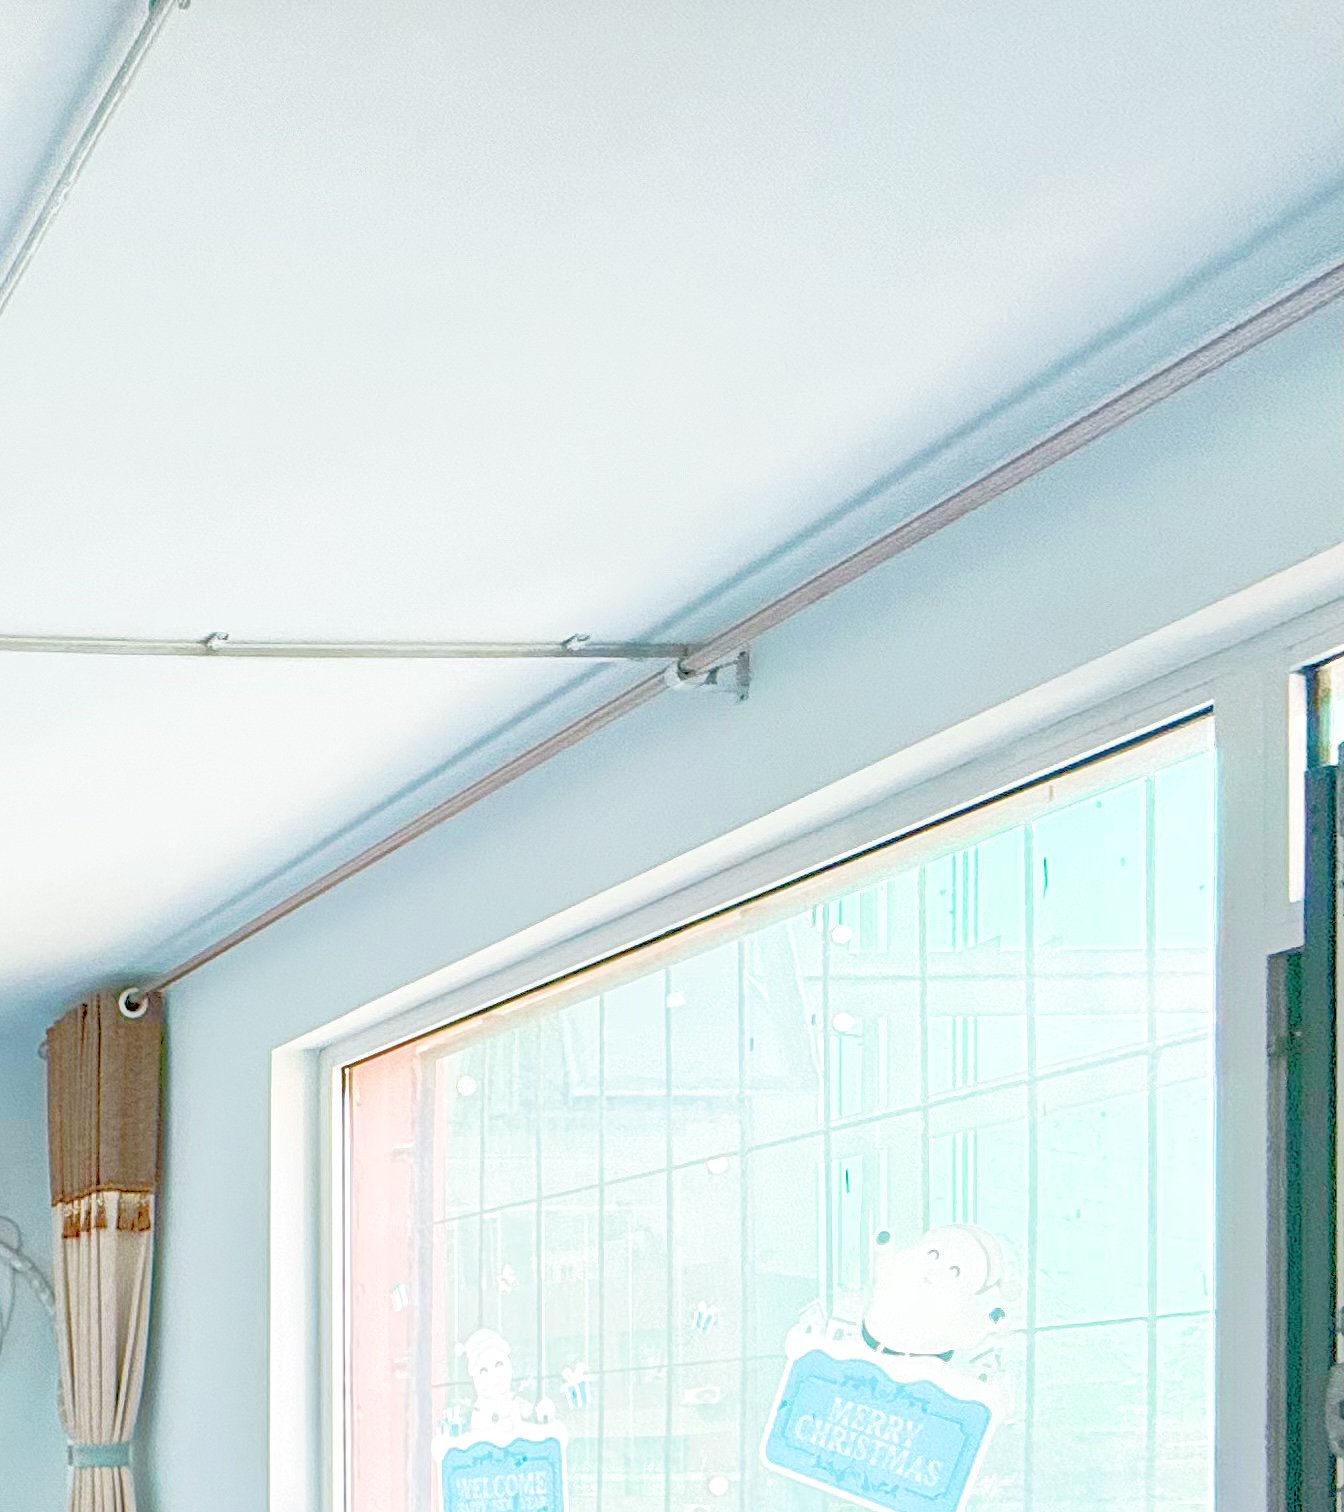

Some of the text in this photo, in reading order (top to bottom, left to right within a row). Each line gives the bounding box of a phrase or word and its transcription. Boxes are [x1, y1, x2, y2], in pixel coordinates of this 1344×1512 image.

[827, 1396, 924, 1448] MERRY
[794, 1414, 946, 1488] CHRISTMAS
[455, 1471, 548, 1499] WELCOME
